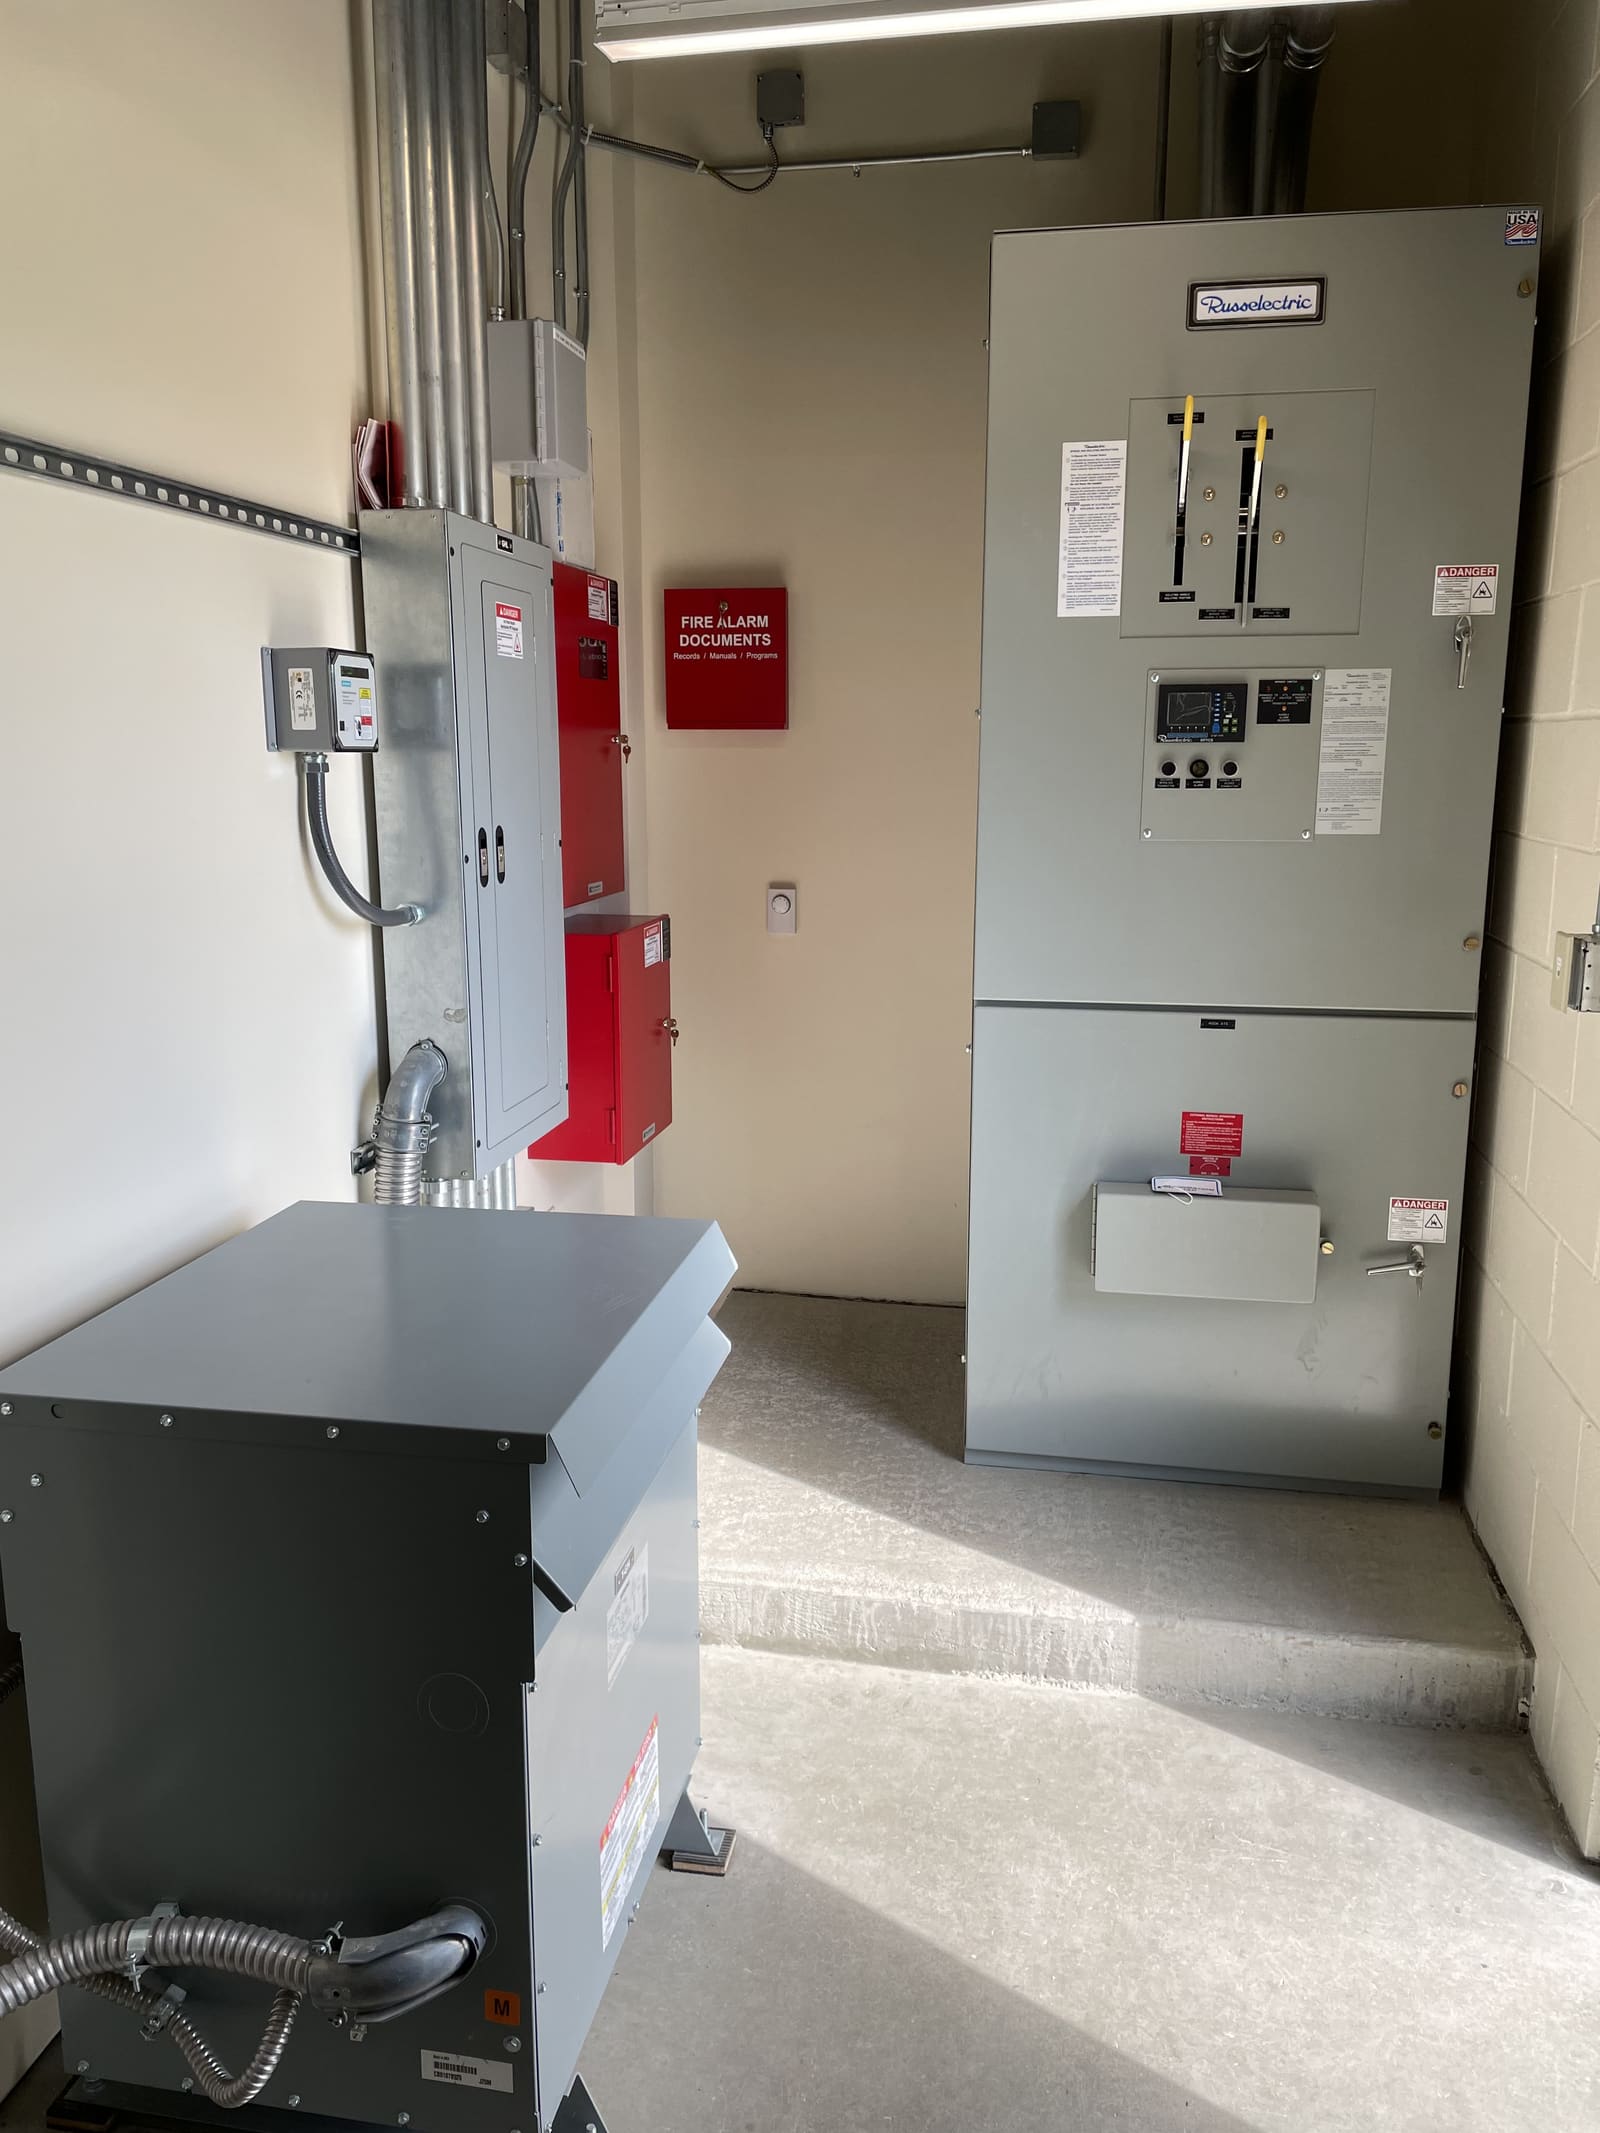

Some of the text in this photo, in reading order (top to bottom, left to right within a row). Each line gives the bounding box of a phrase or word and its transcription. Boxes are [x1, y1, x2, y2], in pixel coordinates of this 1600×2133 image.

[1507, 214, 1537, 225] USA
[1200, 294, 1313, 314] Russelectric
[1449, 567, 1495, 576] DANGER
[681, 615, 769, 629] FIRE ALARM
[679, 634, 771, 647] DOCUMENTS
[673, 652, 700, 660] Records
[709, 652, 737, 660] Manuals
[746, 652, 778, 661] Programs
[1402, 1200, 1445, 1210] DANGER
[494, 1998, 510, 2017] M
